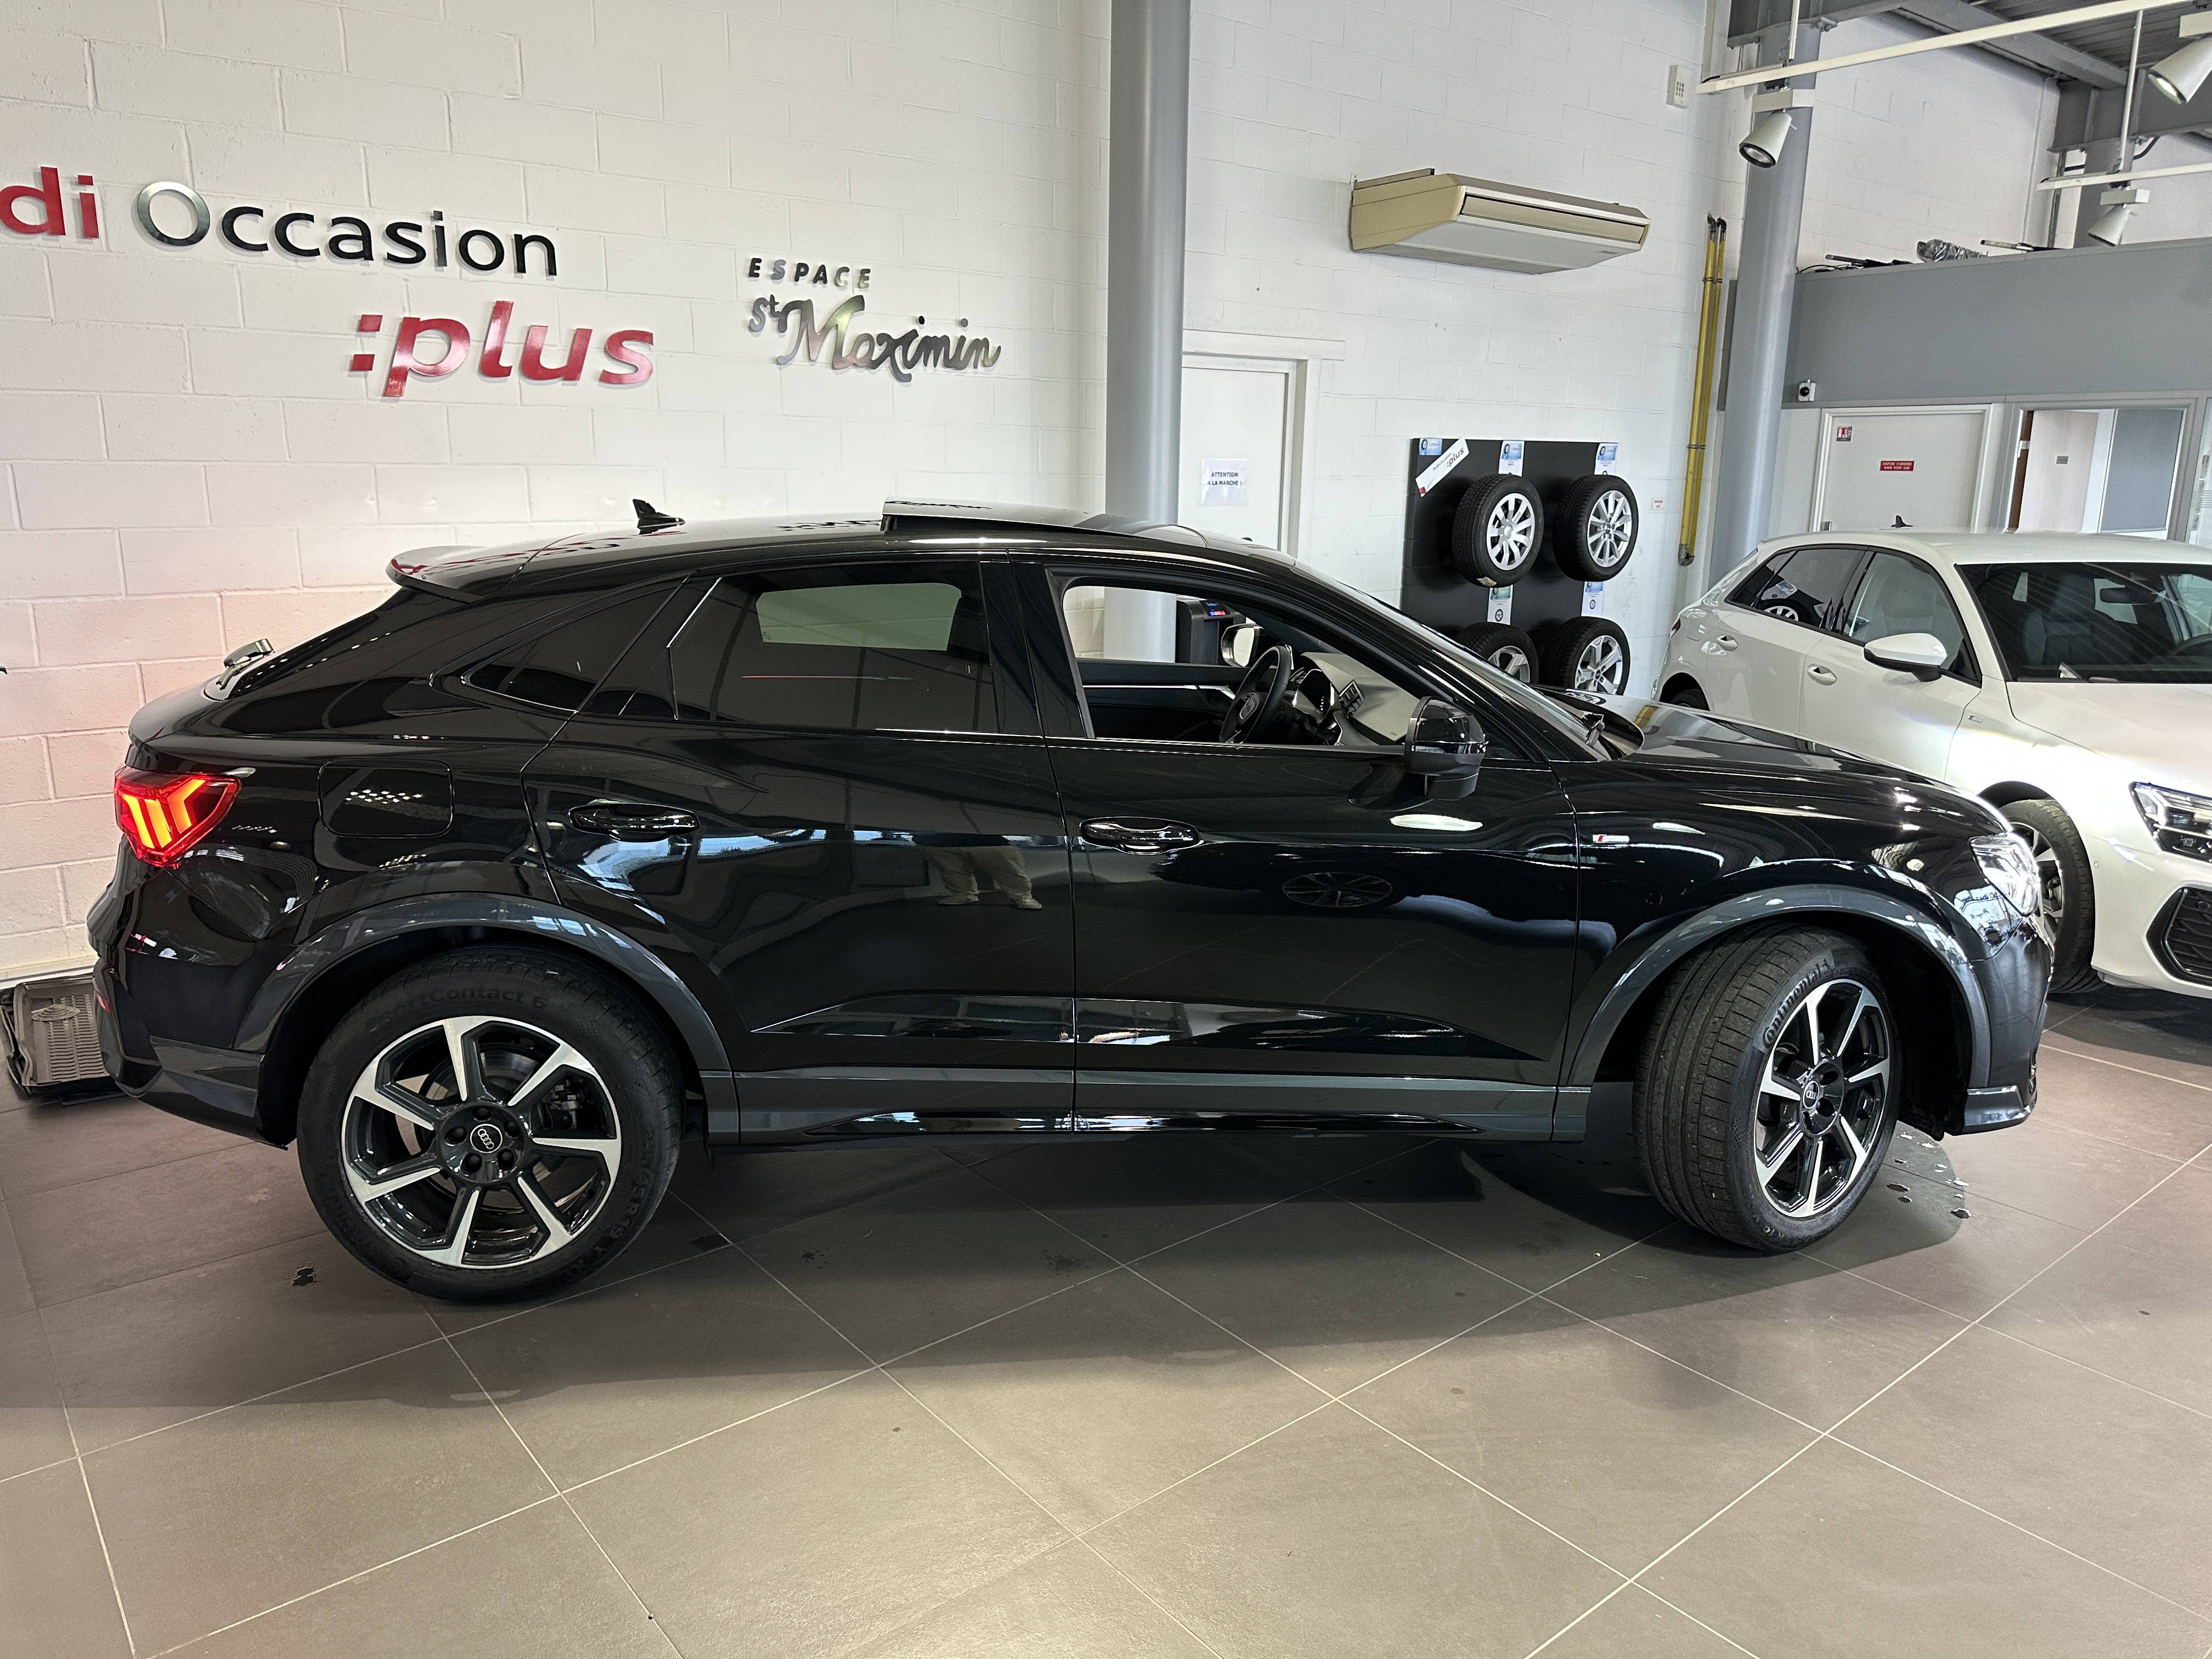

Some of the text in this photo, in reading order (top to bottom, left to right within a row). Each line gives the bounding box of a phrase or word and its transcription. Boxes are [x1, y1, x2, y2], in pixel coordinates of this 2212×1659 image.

[137, 181, 558, 277] Occasion
[748, 257, 871, 289] ESPACE
[350, 300, 654, 397] :plus
[776, 294, 1001, 382] Maximin
[532, 995, 549, 1010] 6
[1762, 963, 1821, 1049] Continental
